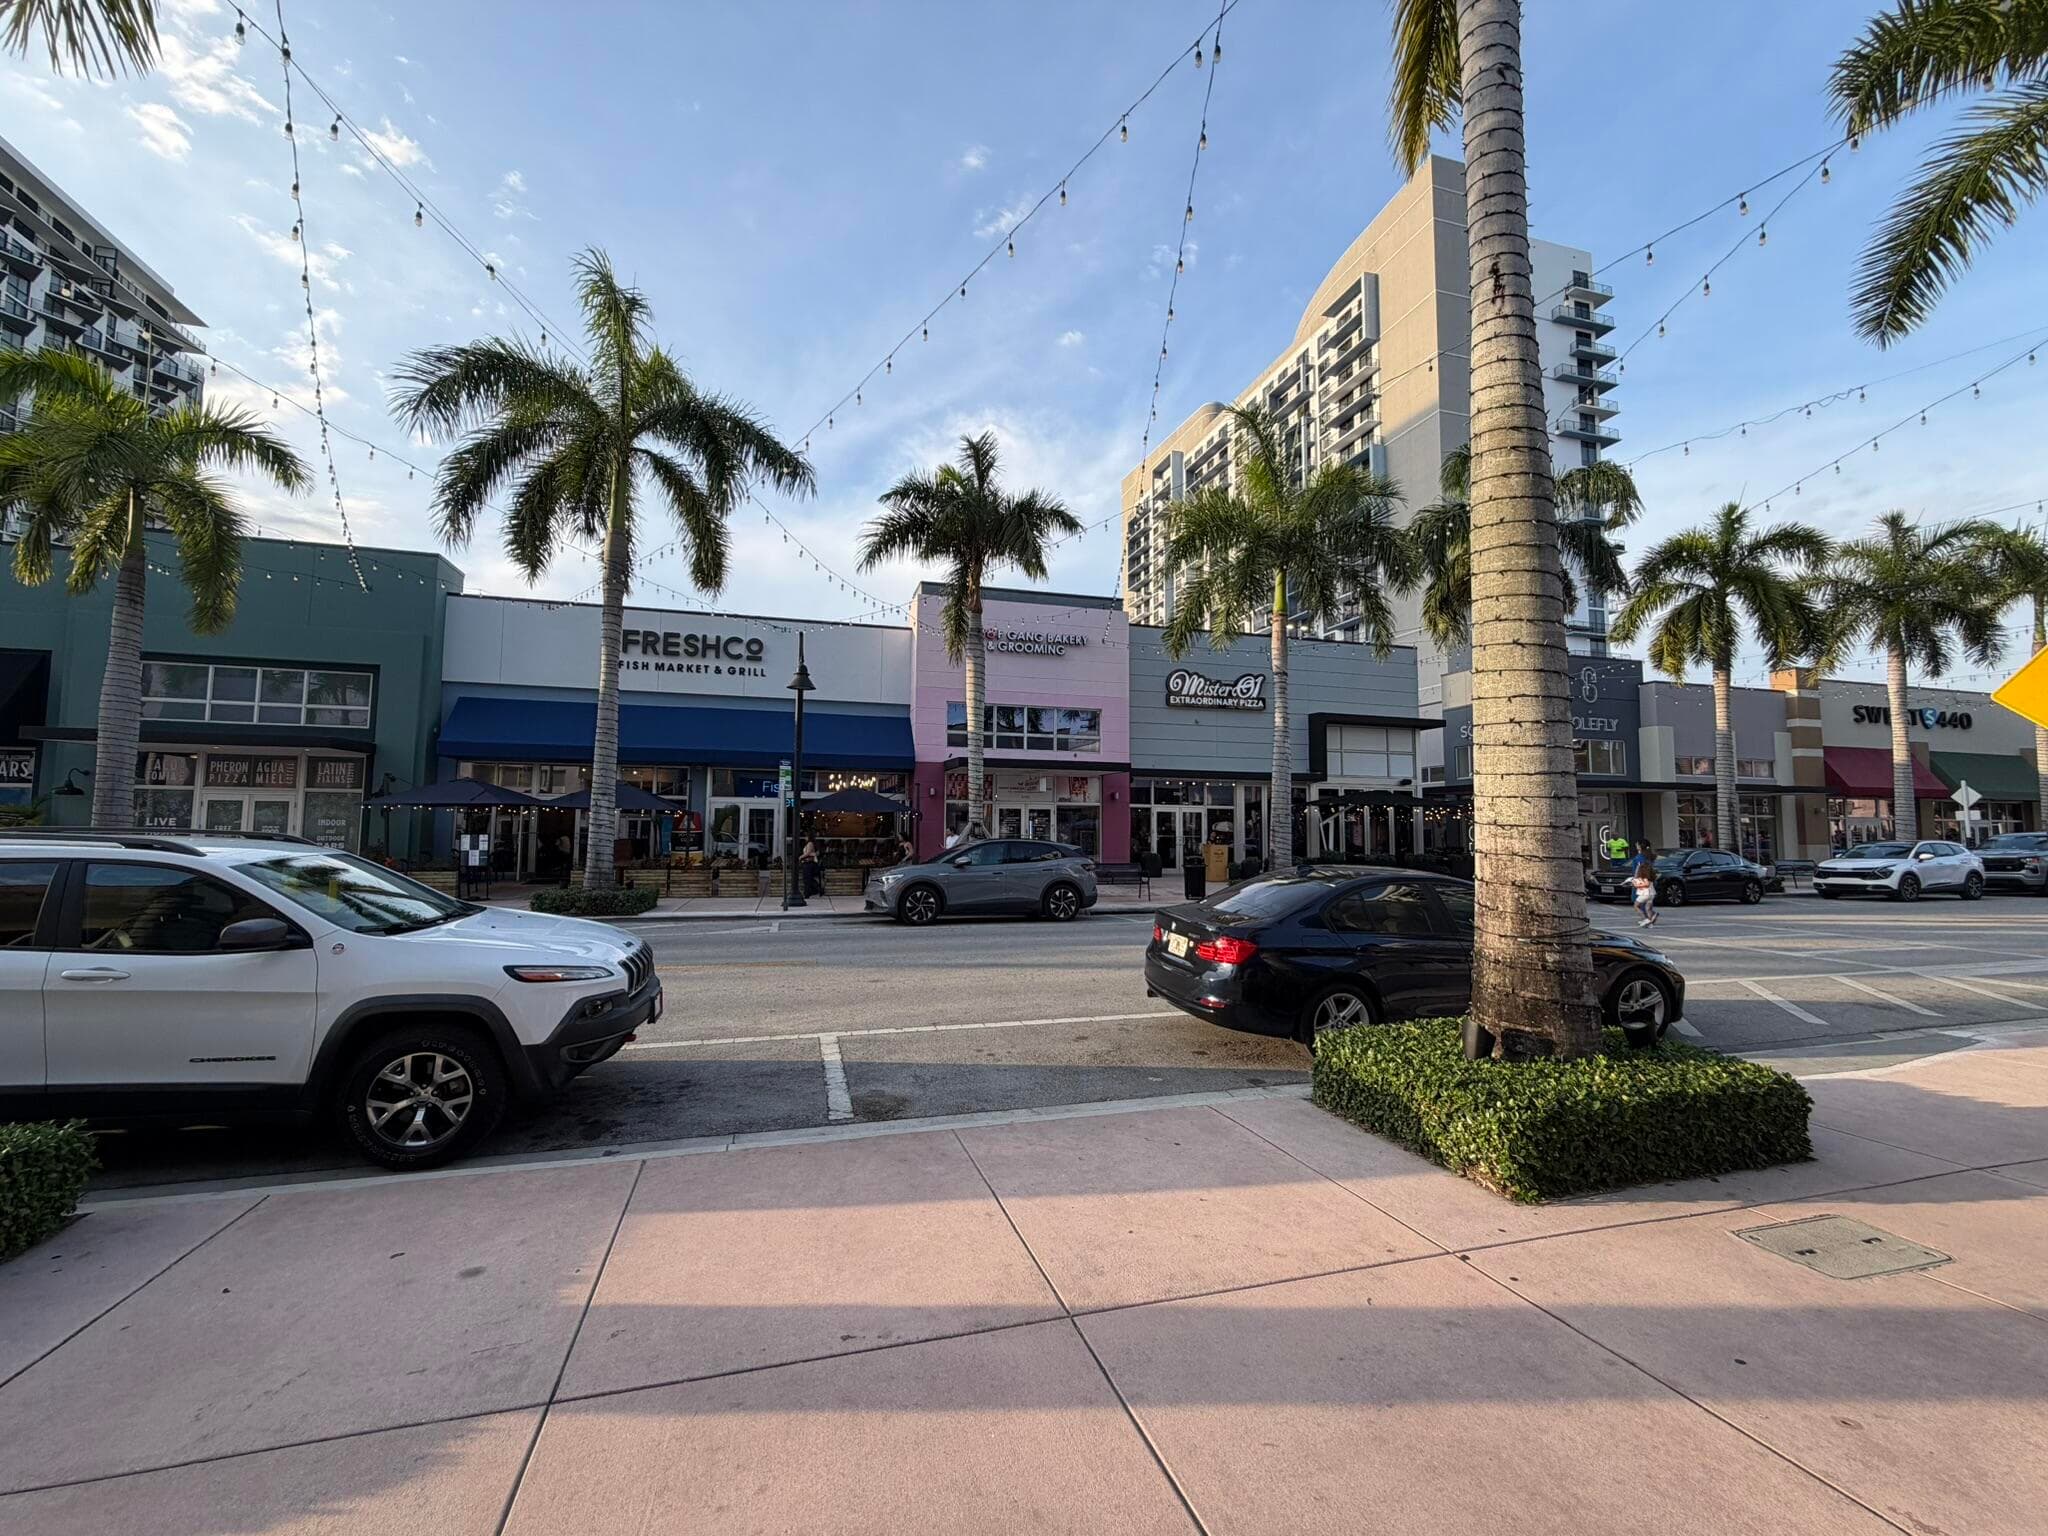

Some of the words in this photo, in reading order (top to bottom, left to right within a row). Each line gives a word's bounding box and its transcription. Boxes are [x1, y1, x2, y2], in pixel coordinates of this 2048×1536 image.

[1007, 630, 1043, 643] GANG
[1047, 633, 1089, 645] BAKERY
[987, 641, 995, 650] &
[998, 641, 1065, 656] GROOMING
[617, 660, 650, 671] FISH
[655, 661, 710, 675] MARKET
[713, 666, 723, 675] &
[727, 666, 767, 677] GRILL
[1170, 695, 1239, 706] EXTRAORDINARY
[1240, 698, 1264, 707] PIZZA
[1853, 704, 1921, 726] SWT
[1936, 711, 1973, 729] 440
[1572, 716, 1619, 733] OLEFLY
[210, 761, 249, 774] PHERON
[256, 761, 284, 773] AGUA
[318, 762, 346, 774] LATIN
[208, 773, 248, 784] PIZZA
[255, 773, 283, 784] MIEL
[145, 817, 177, 827] LIVE
[317, 819, 346, 827] INDOOR
